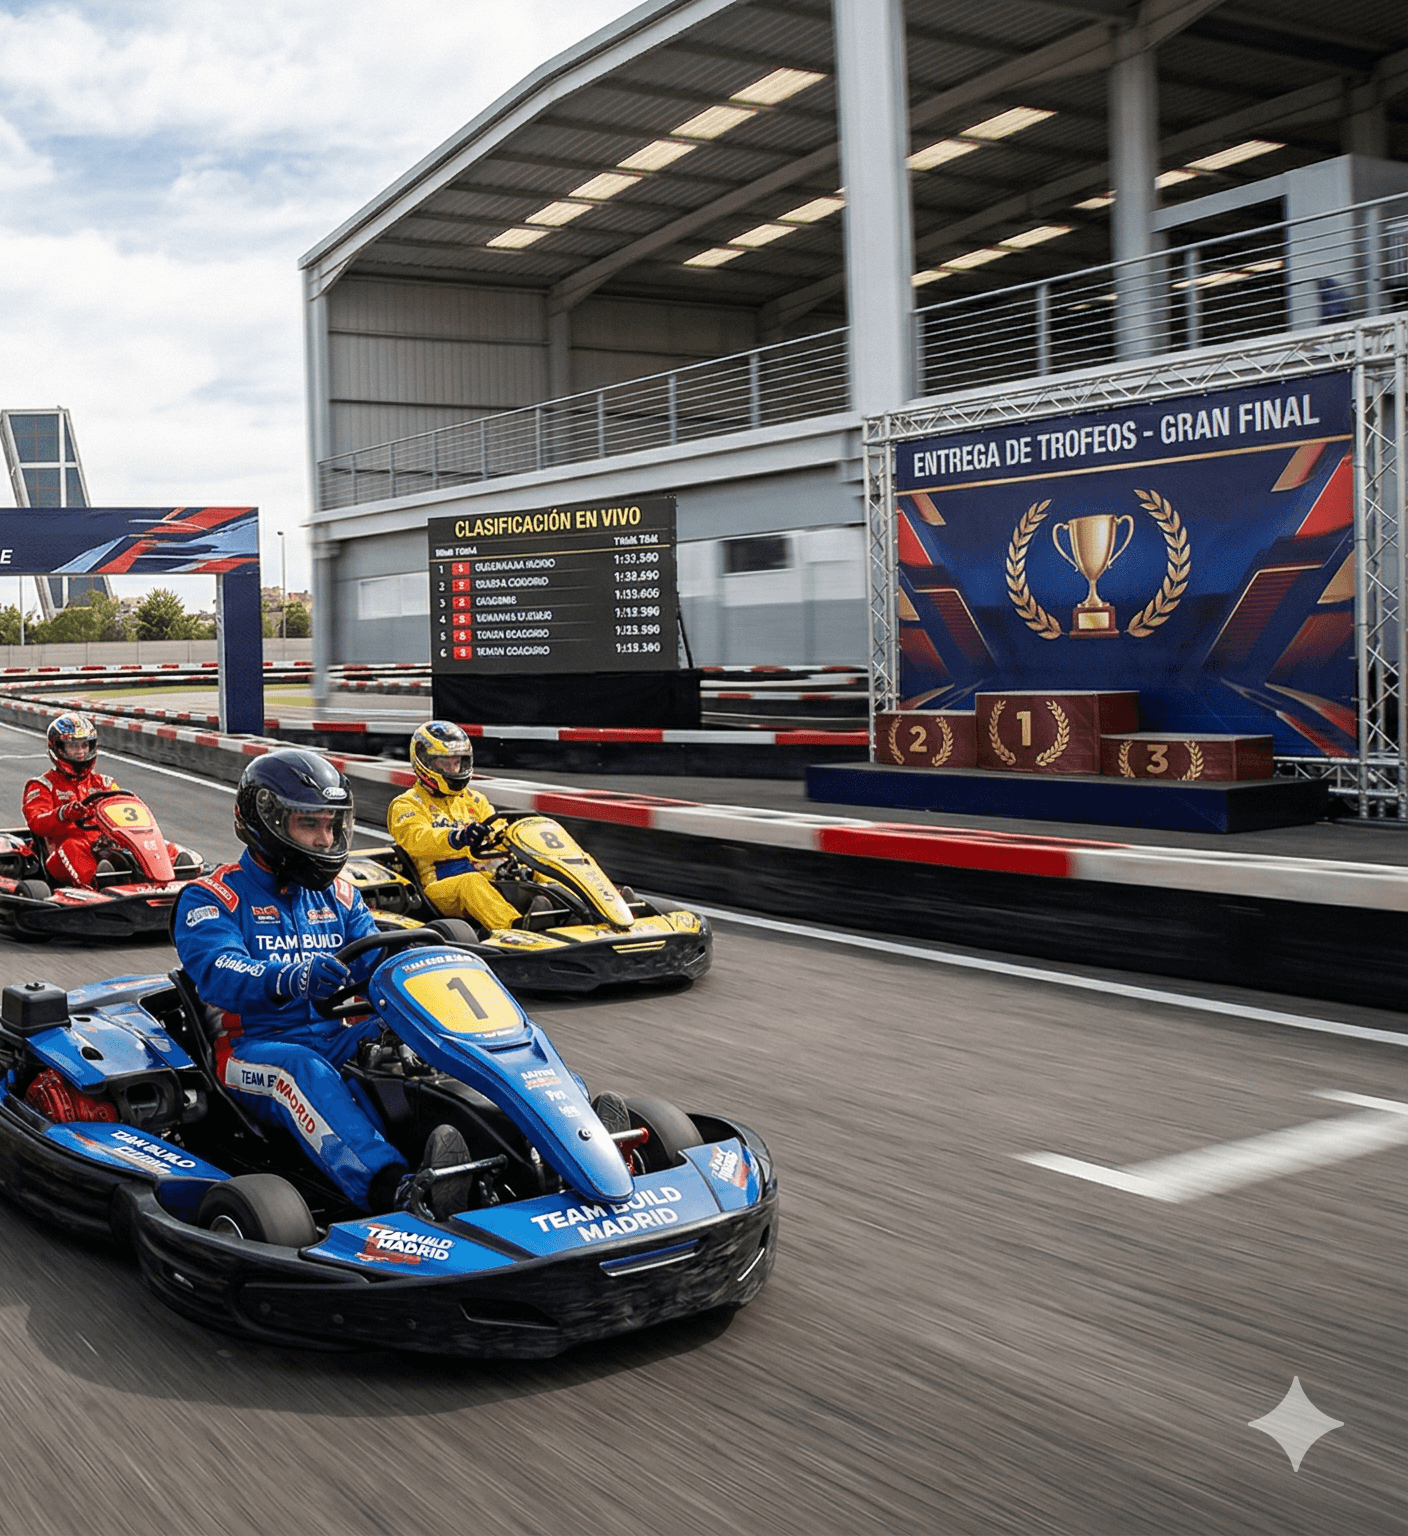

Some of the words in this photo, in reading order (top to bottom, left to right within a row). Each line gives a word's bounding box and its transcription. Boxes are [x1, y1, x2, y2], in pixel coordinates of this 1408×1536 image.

[913, 442, 1001, 478] ENTREGA
[1005, 437, 1032, 466] DE
[1037, 420, 1138, 462] TROFEOS
[1160, 406, 1230, 445] GRAN
[1239, 394, 1321, 434] FINAL
[454, 508, 571, 538] CLASIFICACIÓN
[575, 510, 598, 529] EN
[600, 506, 641, 527] VIVO
[438, 564, 444, 574] 1
[909, 725, 928, 753] 2
[1016, 710, 1032, 747] 1
[1146, 744, 1169, 774] 3
[122, 807, 138, 822] 3
[539, 831, 565, 849] 8
[255, 934, 299, 950] TEAM
[446, 976, 489, 1021] 1
[530, 1204, 608, 1233] TEAM
[577, 1207, 679, 1243] MADRID
[376, 1239, 450, 1261] MADRID
